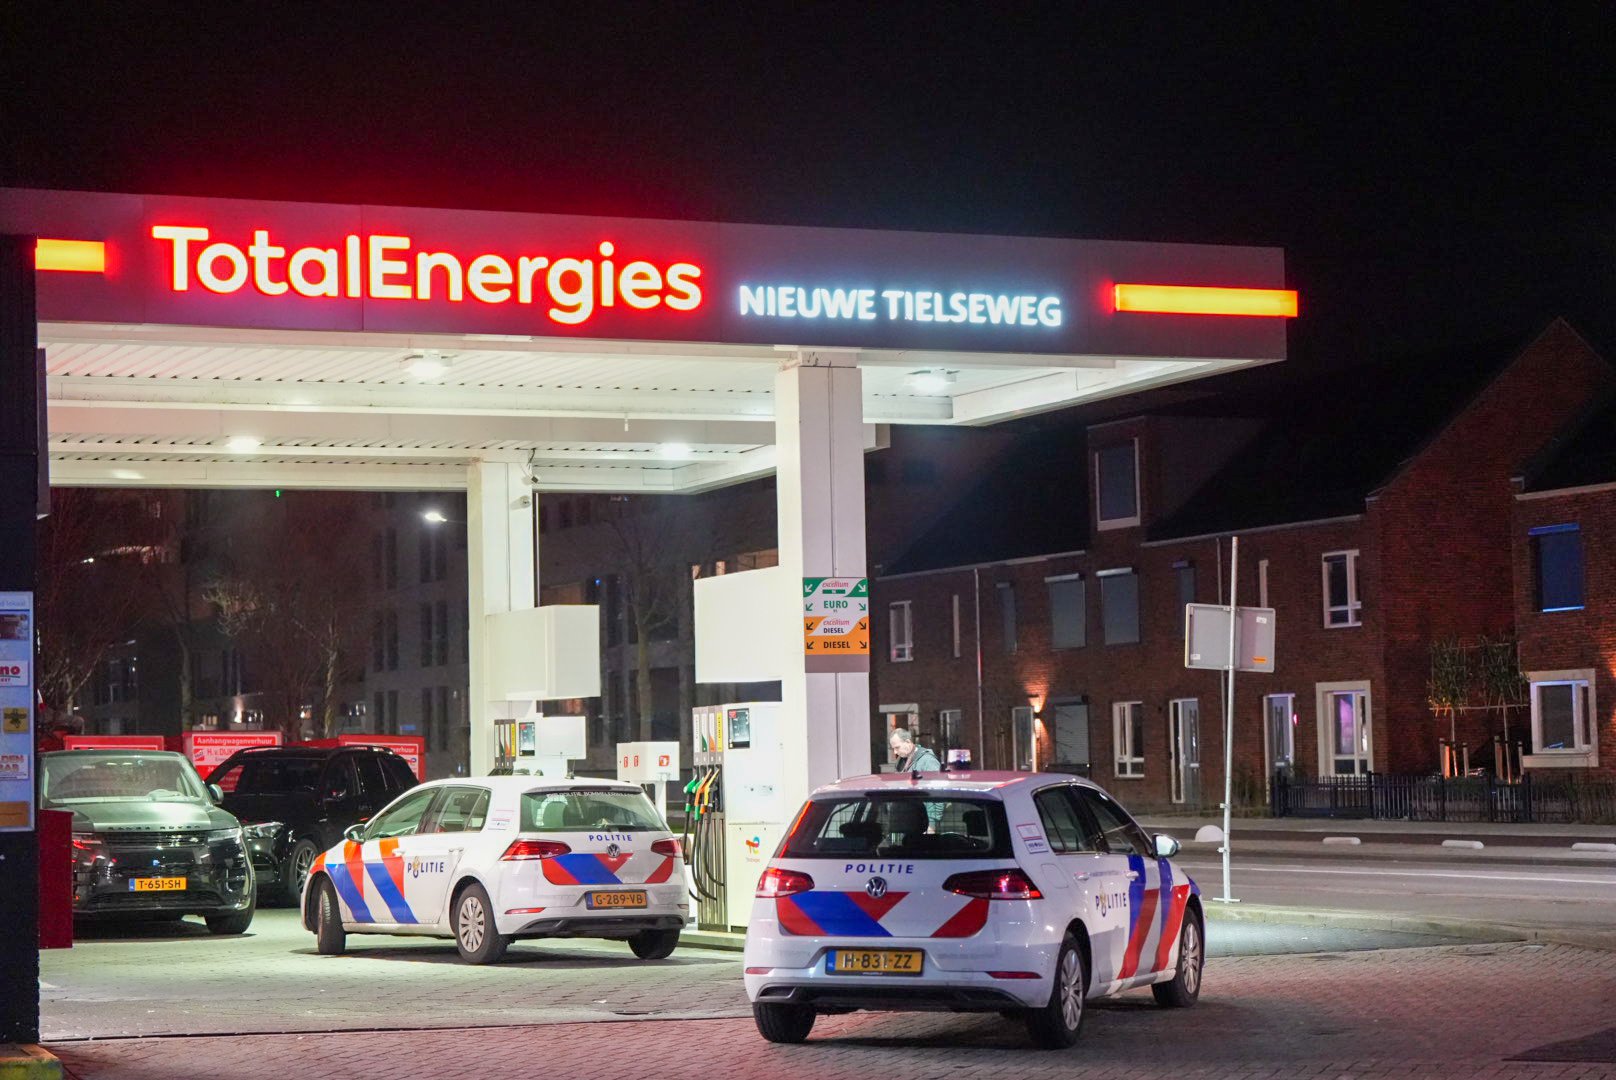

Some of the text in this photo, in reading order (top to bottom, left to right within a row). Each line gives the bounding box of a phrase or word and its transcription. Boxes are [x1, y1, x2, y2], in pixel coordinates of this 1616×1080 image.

[151, 226, 702, 325] TotalEnergies
[739, 285, 1062, 327] NIEUWE TIELSEWEG
[823, 600, 848, 609] EURO
[823, 641, 851, 649] DIESEL
[197, 737, 273, 746] Aanhangwagenverhuur
[588, 834, 633, 842] POLITIE
[845, 863, 914, 874] POLITIE
[139, 880, 181, 889] T-651-SH
[595, 894, 643, 905] G-289-VB
[843, 955, 912, 969] H-831-ZZ
